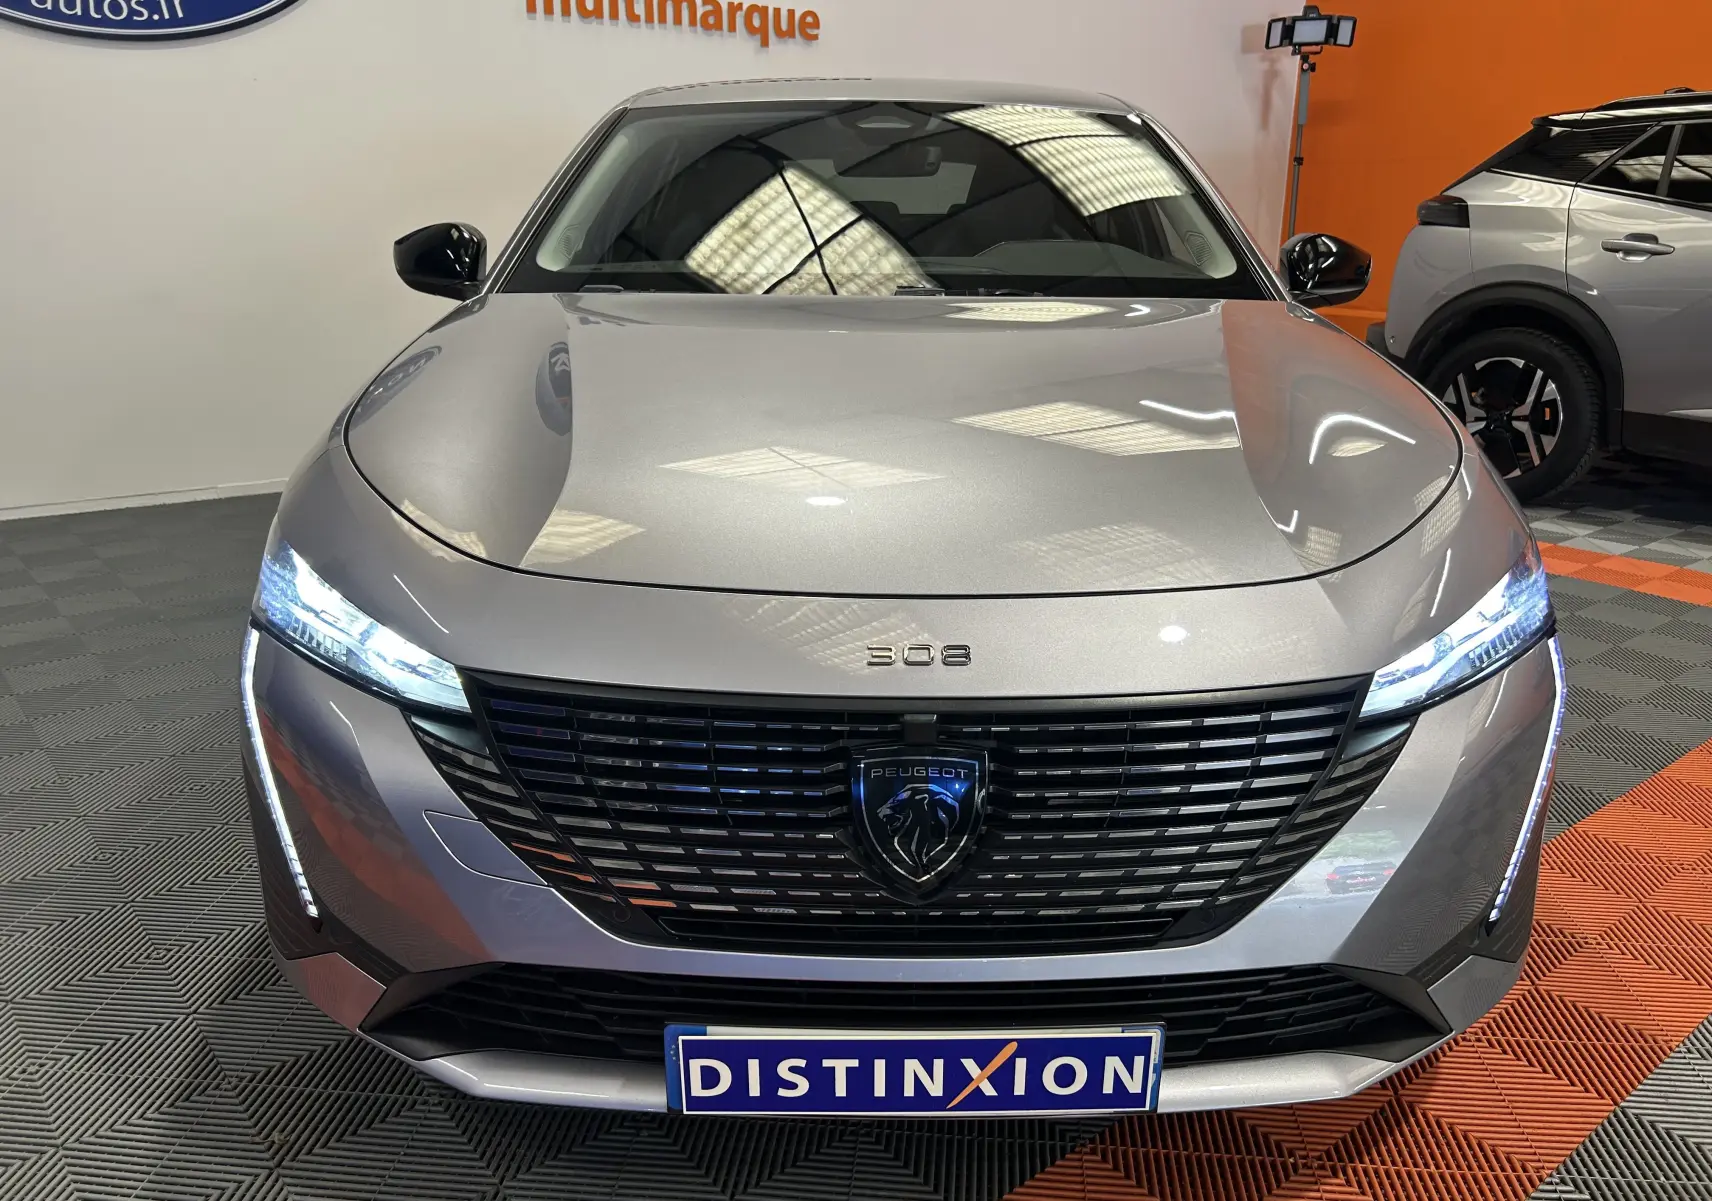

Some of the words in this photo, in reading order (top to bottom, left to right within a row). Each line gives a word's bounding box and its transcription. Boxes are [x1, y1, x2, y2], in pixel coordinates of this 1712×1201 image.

[867, 644, 971, 666] 308
[871, 766, 968, 779] PEUGEOT
[689, 1041, 1145, 1108] DISTINXION
